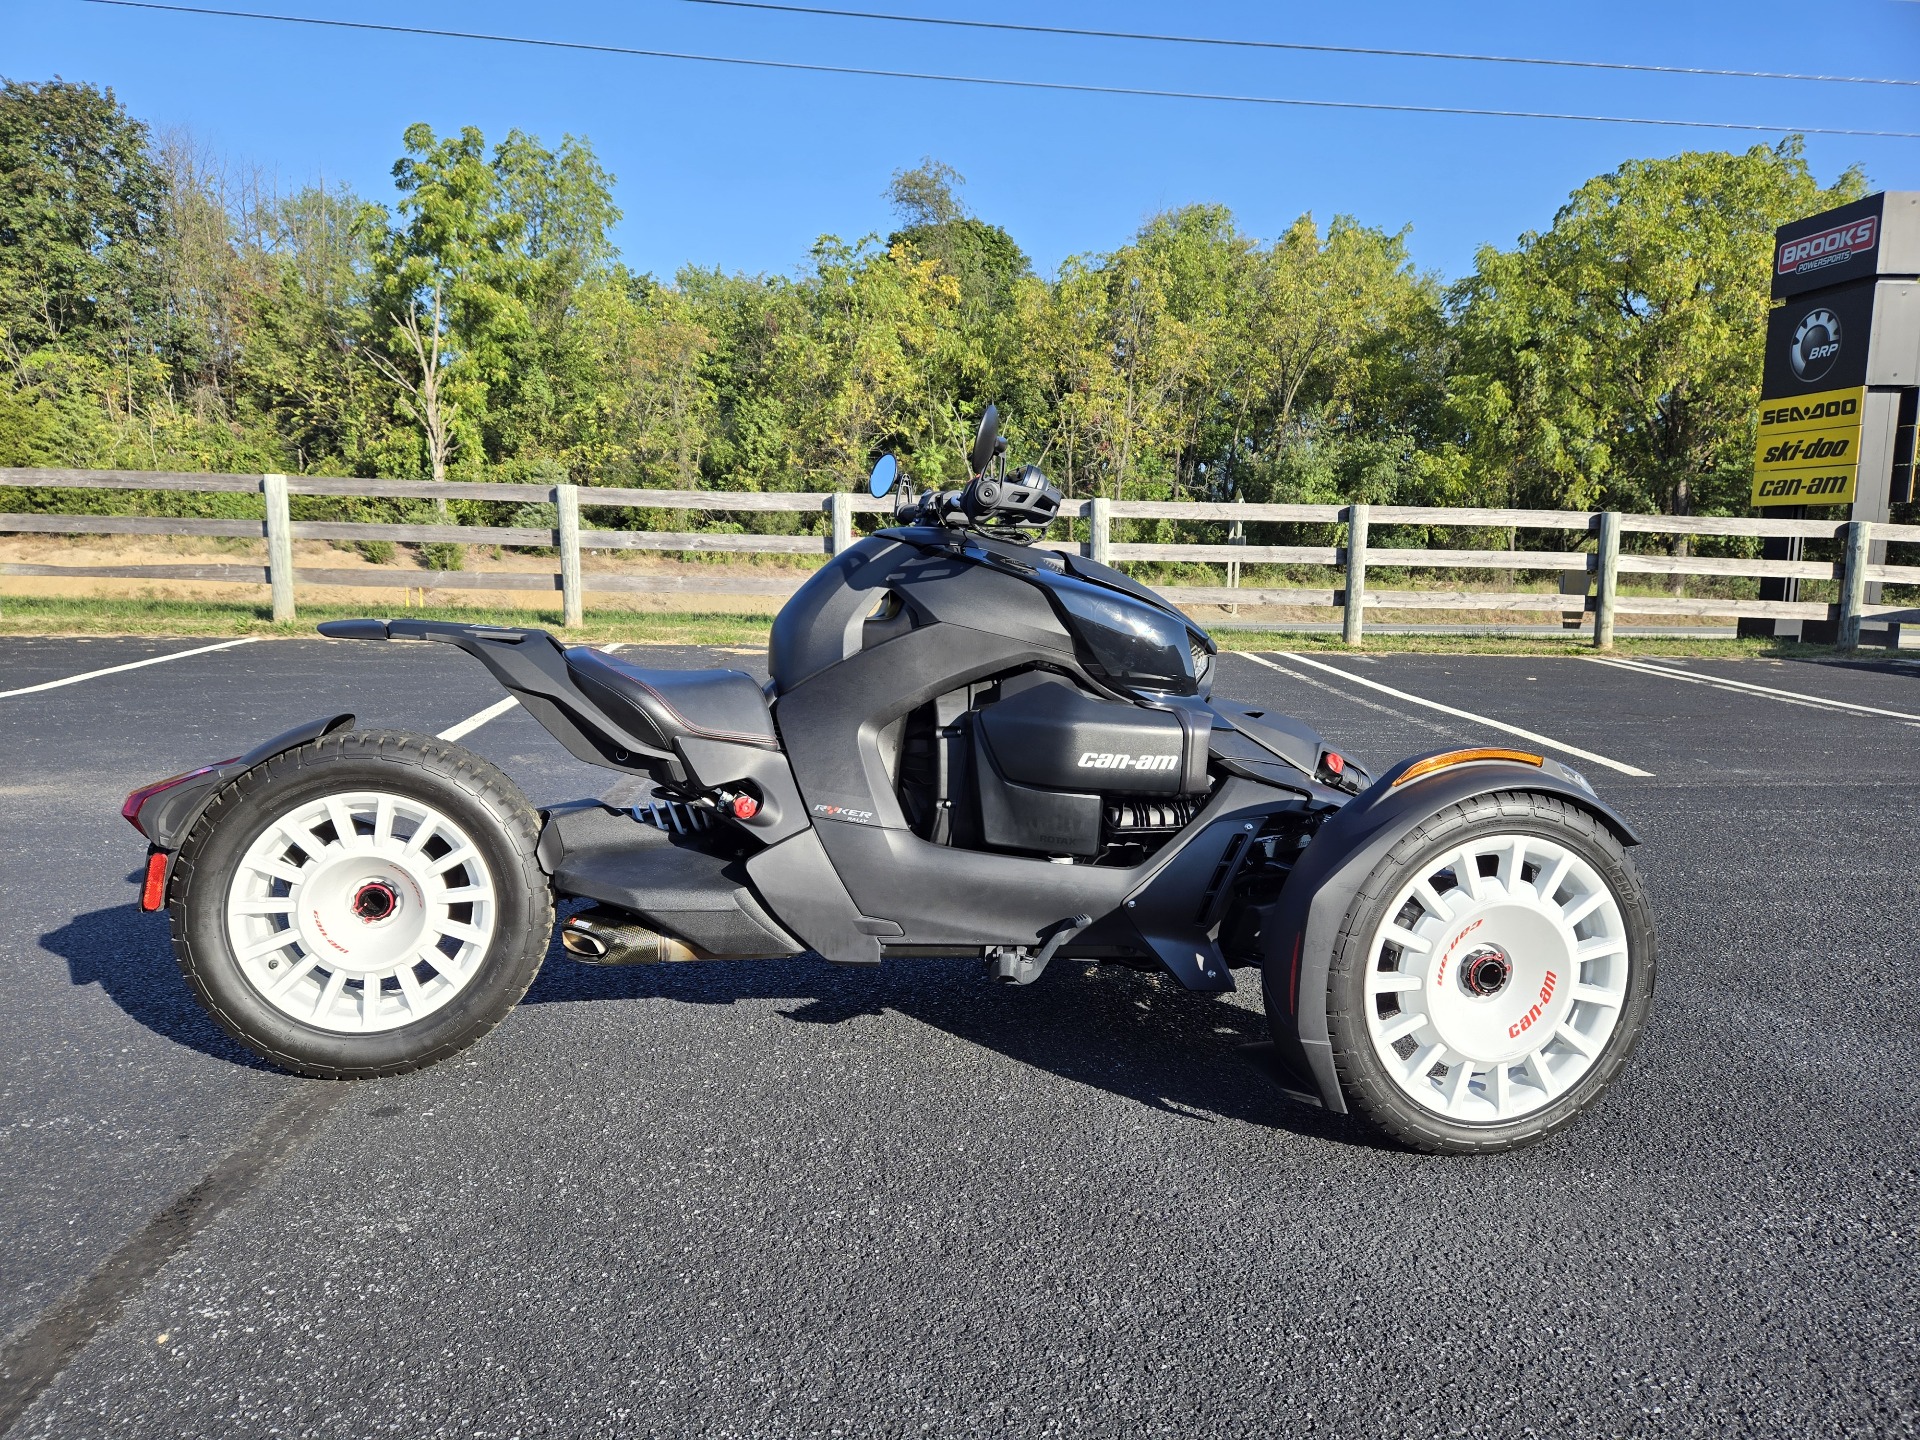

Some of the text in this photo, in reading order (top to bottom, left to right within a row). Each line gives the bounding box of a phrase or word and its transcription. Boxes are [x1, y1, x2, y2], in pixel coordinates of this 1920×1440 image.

[1782, 223, 1873, 265] BROOKS
[1798, 251, 1850, 273] POWERSPORTS
[1809, 344, 1839, 360] BRP
[1763, 438, 1849, 463] ski-doo
[1759, 476, 1847, 497] can-am
[1078, 752, 1178, 770] can-am
[814, 804, 873, 819] RYKER
[846, 816, 868, 824] RALLY
[1606, 864, 1639, 911] KENDA
[1508, 970, 1557, 1039] can-am
